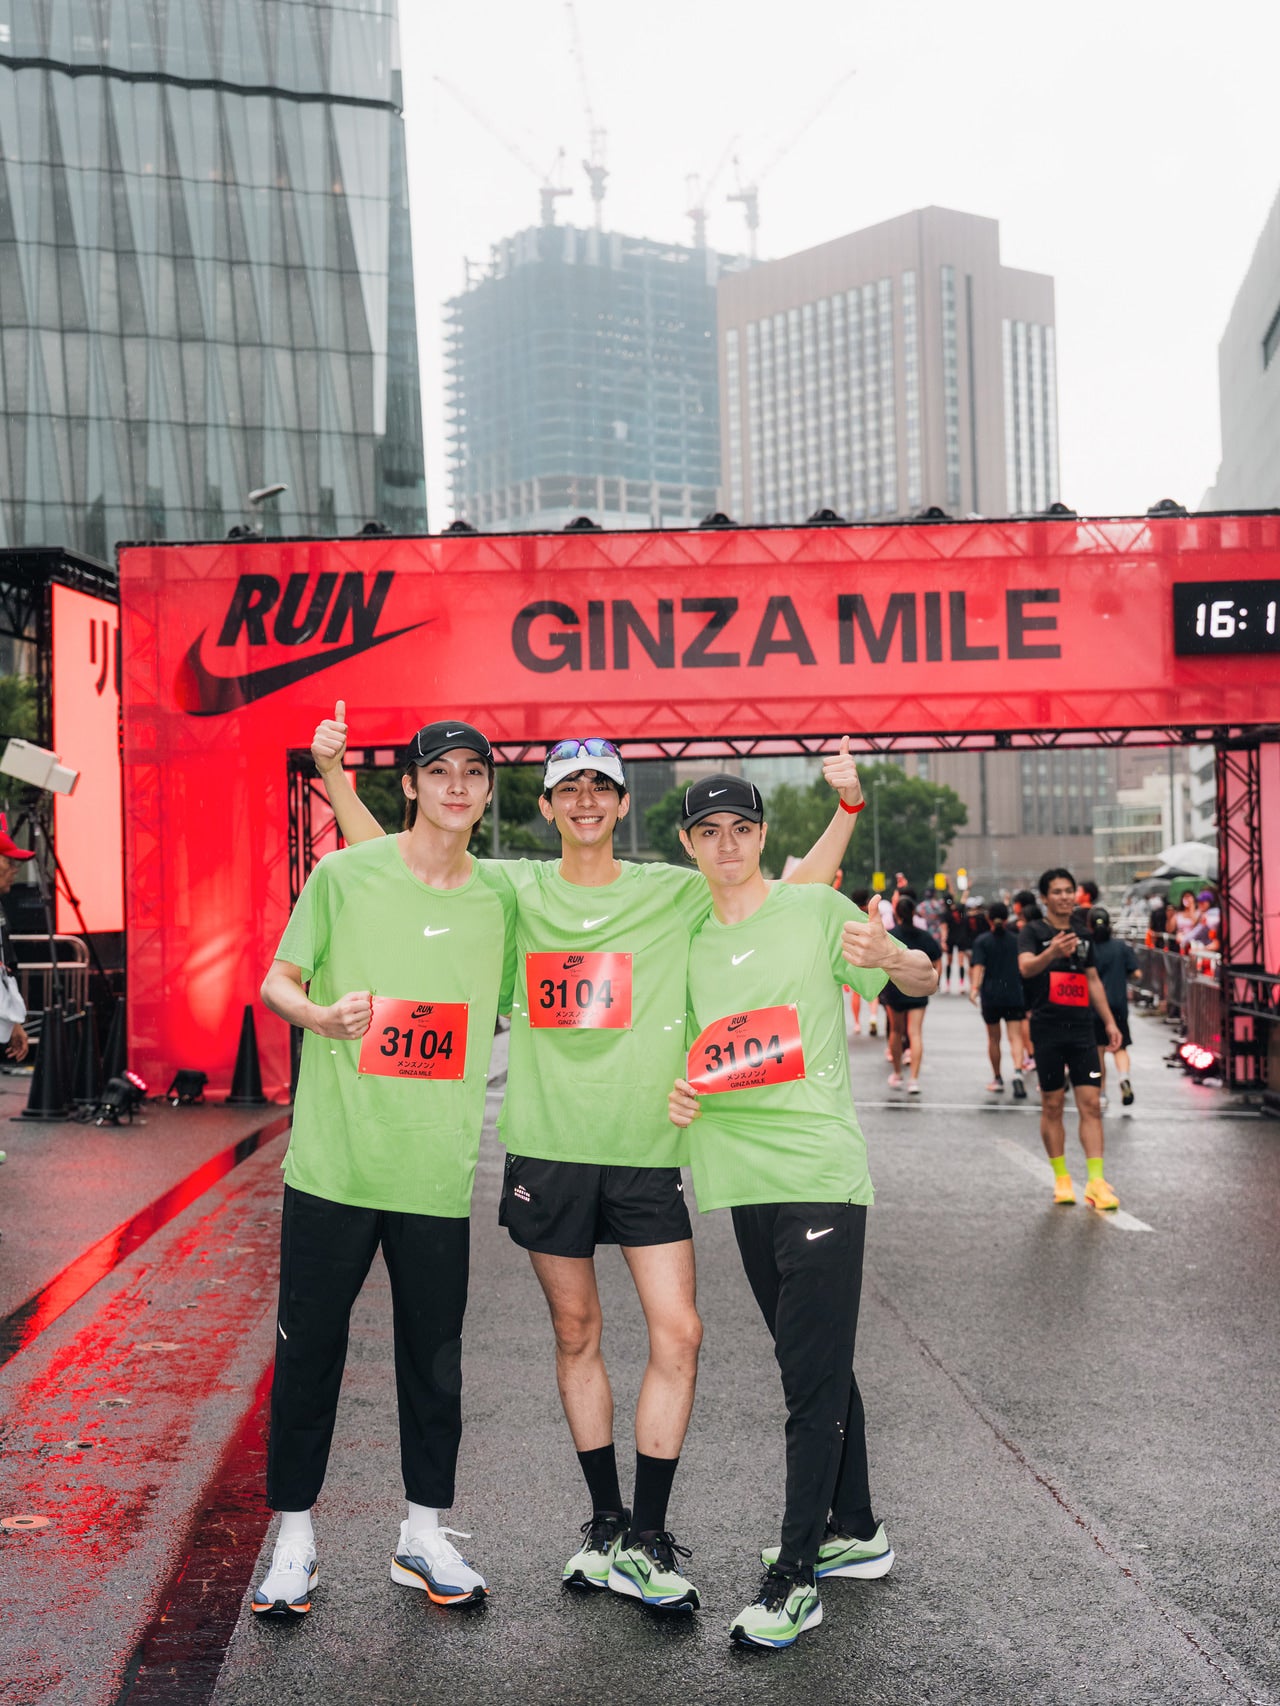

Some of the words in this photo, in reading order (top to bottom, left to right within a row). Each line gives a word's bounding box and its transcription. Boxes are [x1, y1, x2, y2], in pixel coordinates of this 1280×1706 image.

[217, 571, 395, 646] RUN
[511, 596, 817, 674] GINZA
[837, 588, 1062, 665] MILE
[567, 955, 585, 963] RUN
[416, 1004, 434, 1014] RUN
[539, 979, 614, 1009] 3104
[731, 1015, 748, 1025] RUN
[380, 1026, 453, 1060] 3104
[704, 1034, 784, 1073] 3104
[730, 1080, 751, 1088] GINZA
